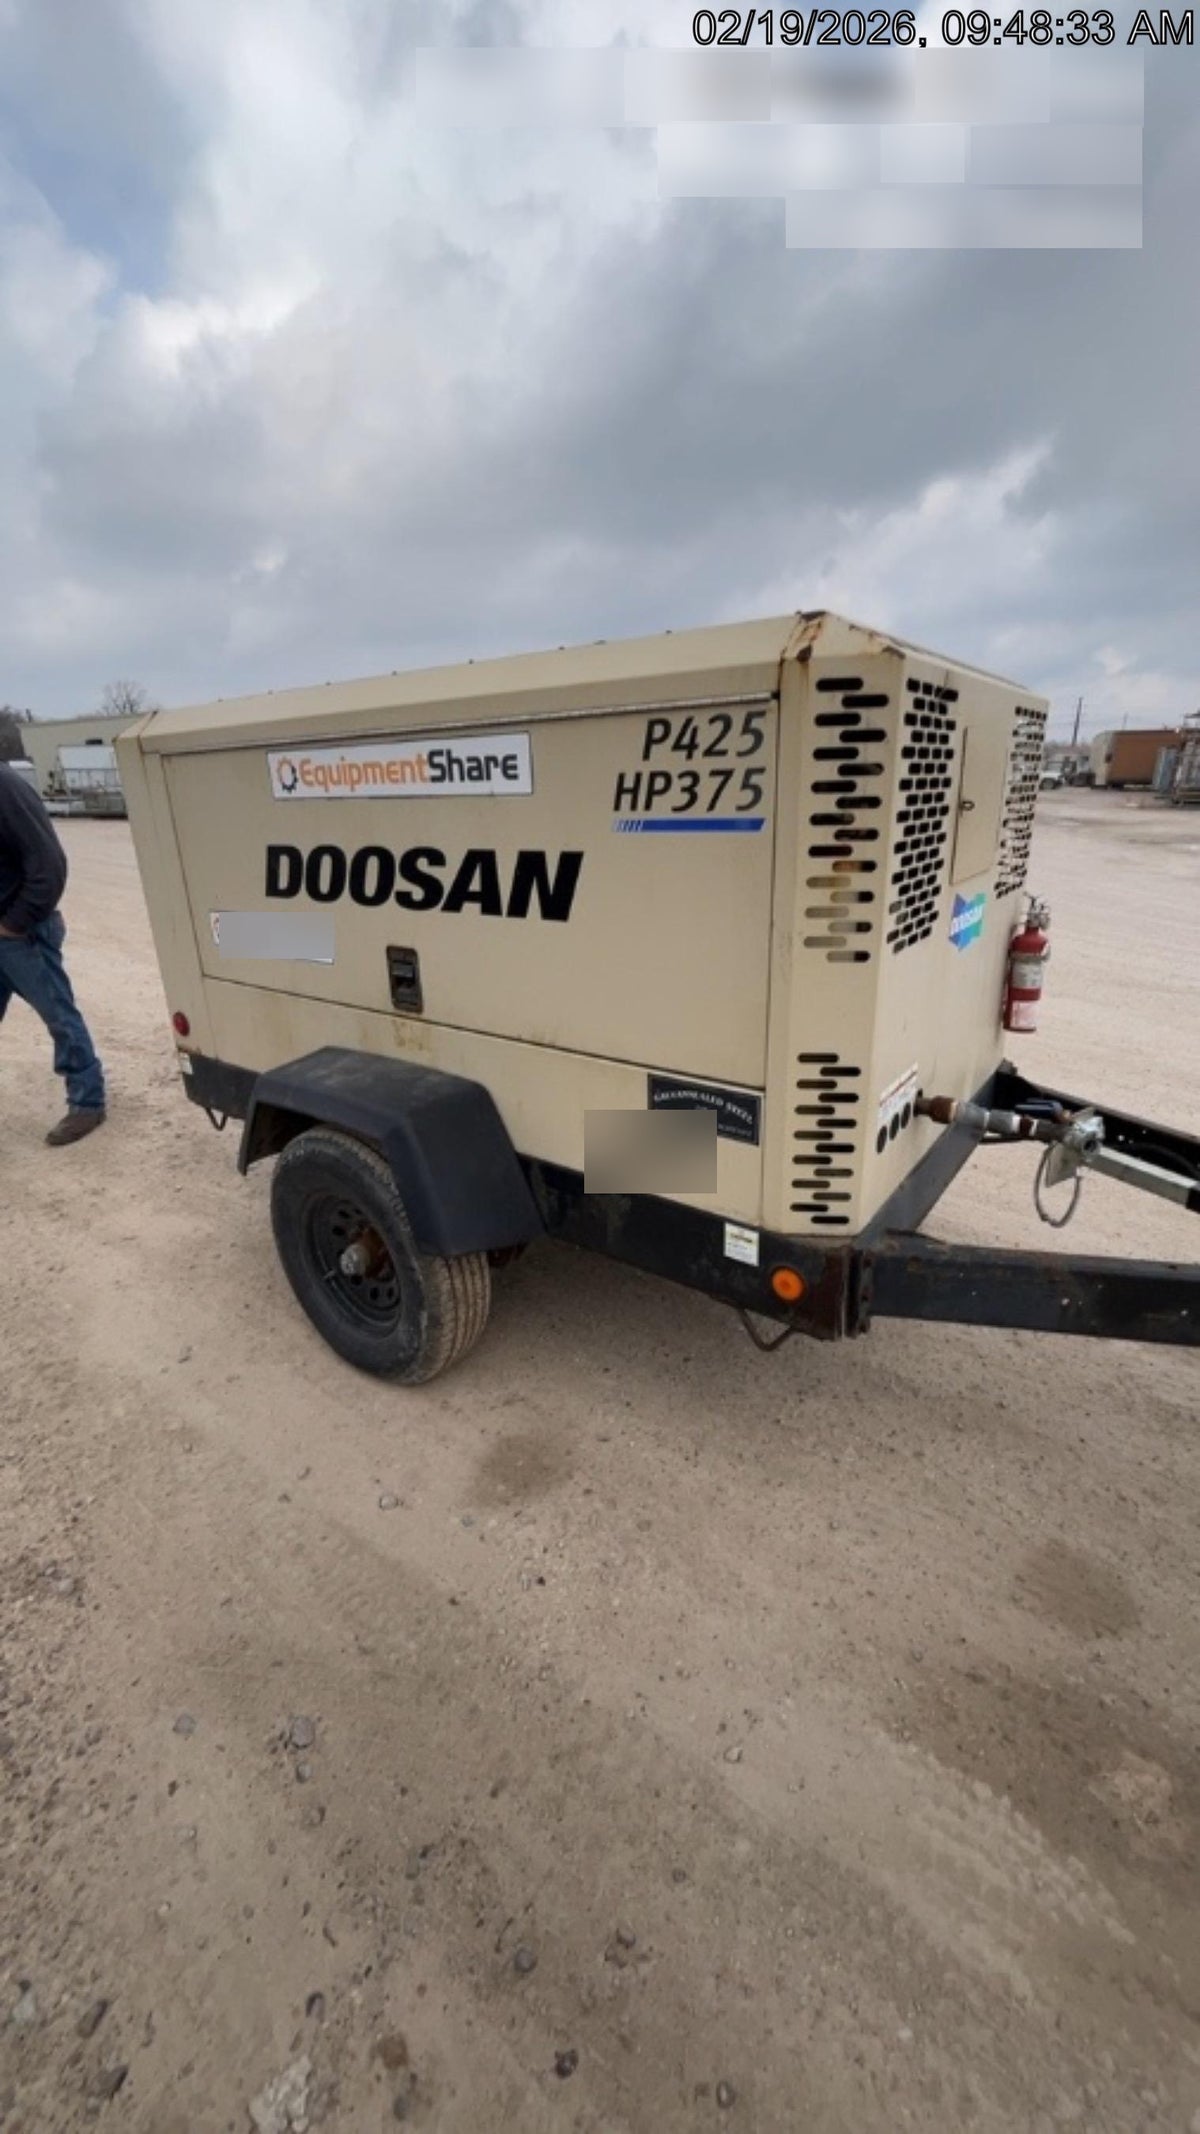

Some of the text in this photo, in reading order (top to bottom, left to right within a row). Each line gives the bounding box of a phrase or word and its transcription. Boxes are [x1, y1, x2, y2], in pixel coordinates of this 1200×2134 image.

[641, 711, 767, 761] P425
[299, 749, 519, 793] EquipmentShare
[612, 767, 767, 813] HP375
[265, 844, 584, 922] DOOSAN
